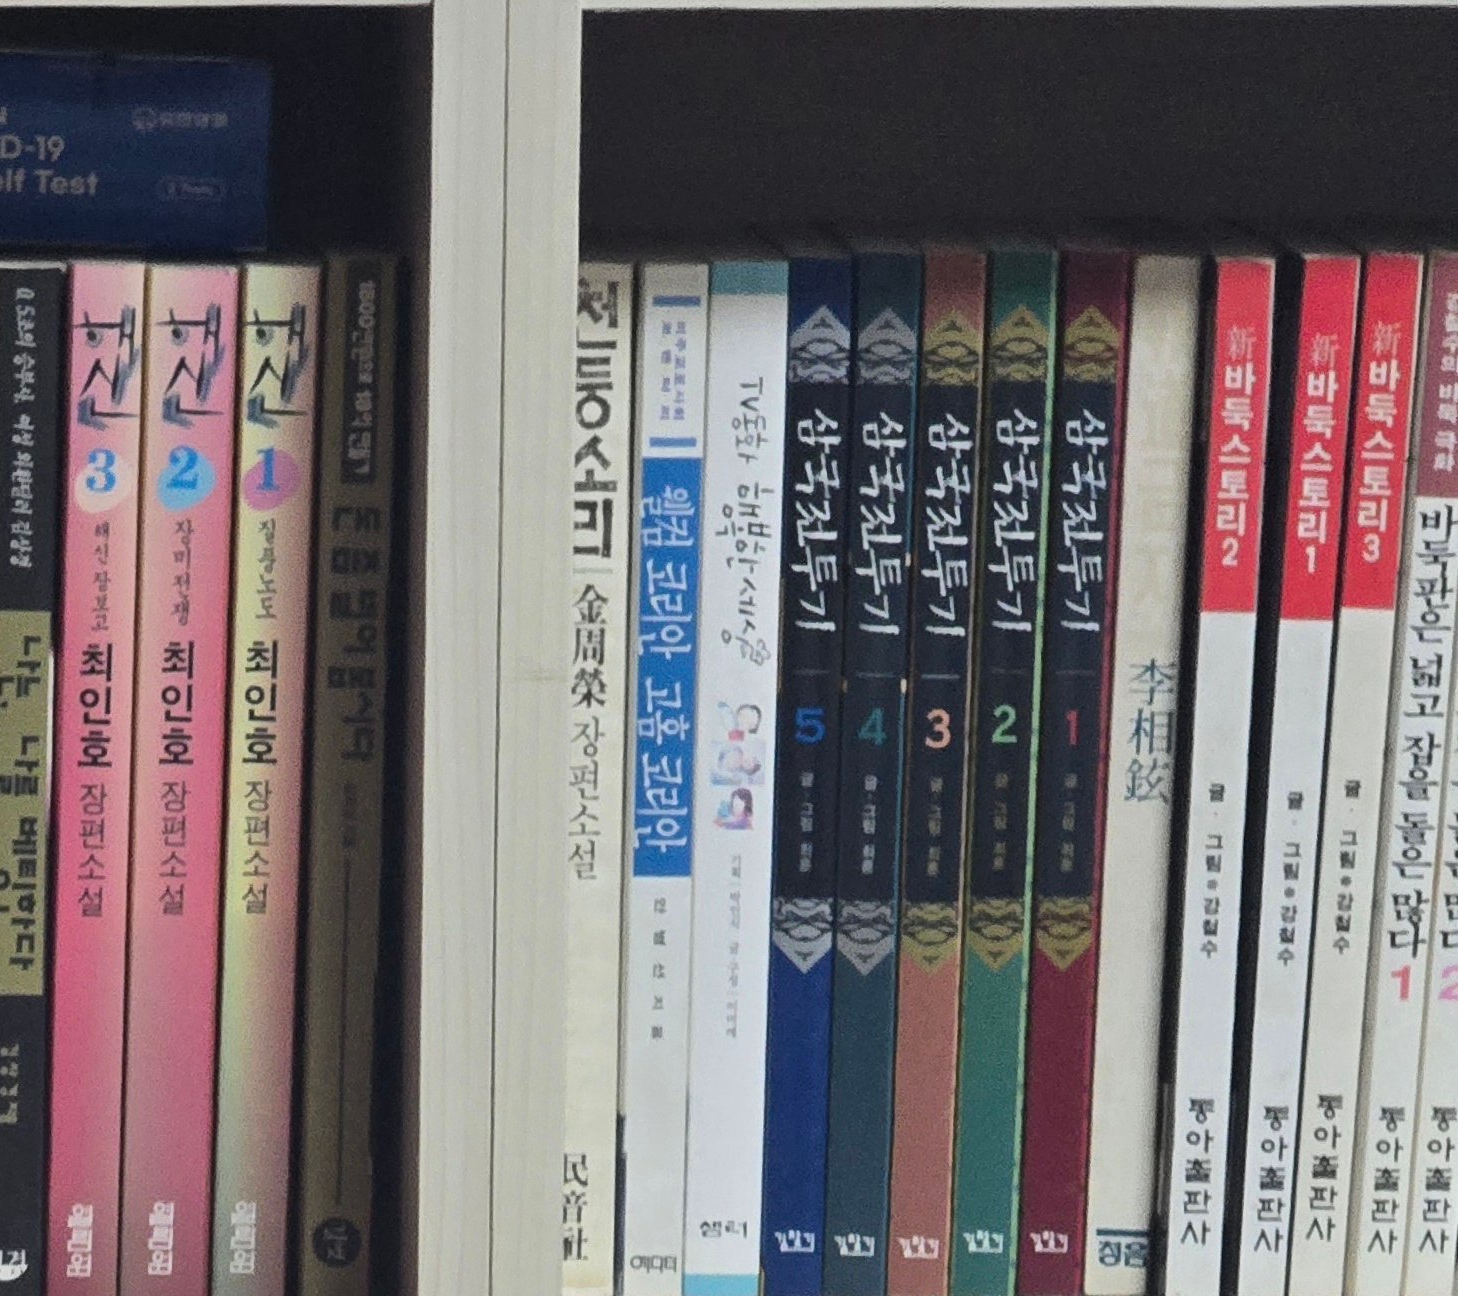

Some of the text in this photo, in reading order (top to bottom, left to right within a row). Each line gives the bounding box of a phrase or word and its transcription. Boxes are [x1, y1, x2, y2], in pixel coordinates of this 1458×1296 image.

[32, 169, 100, 196] Test
[85, 448, 116, 492] 3
[165, 446, 199, 490] 2
[732, 376, 768, 464] TV동화
[1215, 363, 1255, 566] 바둑스토리 2
[1296, 369, 1339, 544] 바둑스토리
[1357, 359, 1400, 563] 바둑스토리 3
[792, 408, 844, 631] 삼국전투기
[854, 412, 909, 636] 삼국전투기
[921, 413, 974, 637] 삼국전투기
[242, 639, 278, 764] 최인호
[796, 706, 826, 745] 5
[859, 707, 887, 745] 4
[1065, 709, 1079, 746] 1
[76, 642, 114, 917] 최인호 장편소설
[159, 640, 195, 916] 최인호 장편소설
[1181, 1098, 1215, 1246] 동아출판사
[1254, 1106, 1289, 1252] 동아출판사
